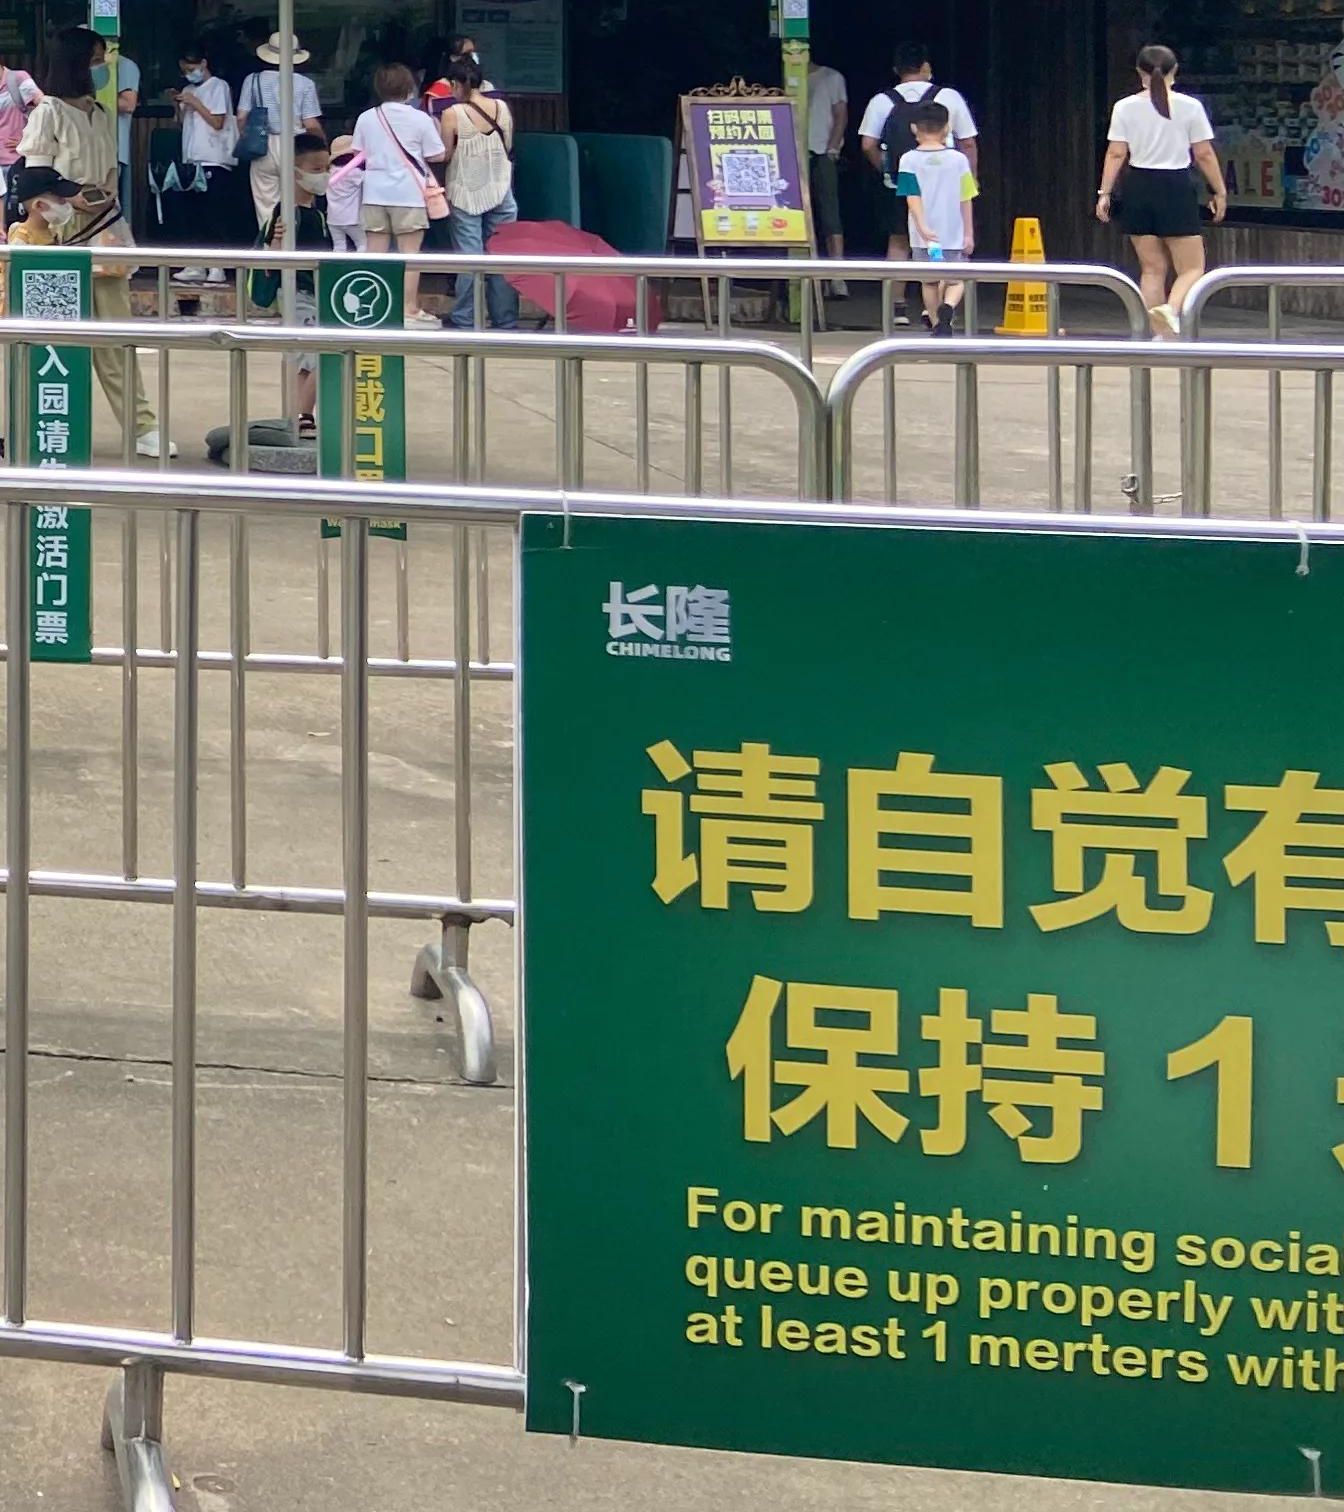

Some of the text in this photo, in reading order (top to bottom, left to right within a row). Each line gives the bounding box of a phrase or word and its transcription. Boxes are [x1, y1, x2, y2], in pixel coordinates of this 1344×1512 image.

[1225, 160, 1274, 197] ALE
[601, 581, 731, 644] 长隆
[605, 641, 731, 662] CHIMELONG
[641, 739, 1344, 948] 请自觉有
[685, 1186, 1344, 1277] For maintaining socia
[685, 1255, 1344, 1336] queue up properly wit
[685, 1305, 744, 1348] at
[761, 1305, 907, 1359] least
[921, 1320, 948, 1363] 1
[969, 1331, 1209, 1384] merters
